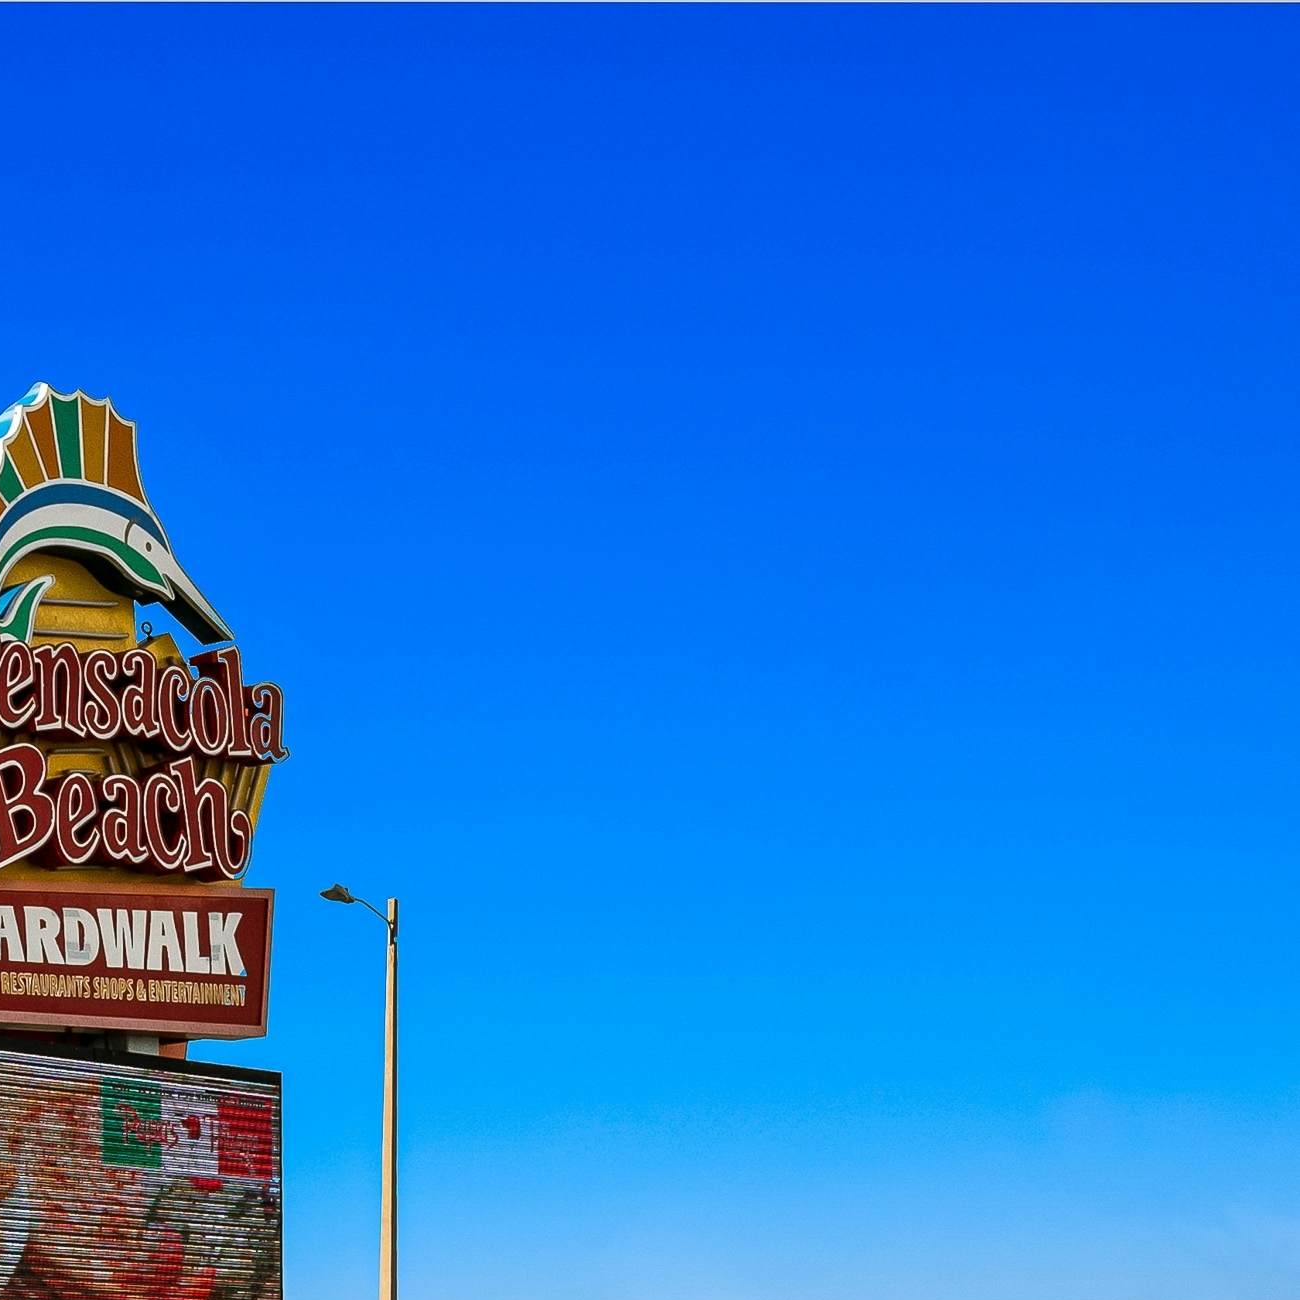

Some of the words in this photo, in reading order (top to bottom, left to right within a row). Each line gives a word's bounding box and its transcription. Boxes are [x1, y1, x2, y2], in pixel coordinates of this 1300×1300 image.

[1, 971, 90, 998] RESTAURANTS
[93, 976, 134, 1001] SHOPS
[136, 978, 147, 1001] &
[150, 979, 246, 1006] ENTERTAINMENT
